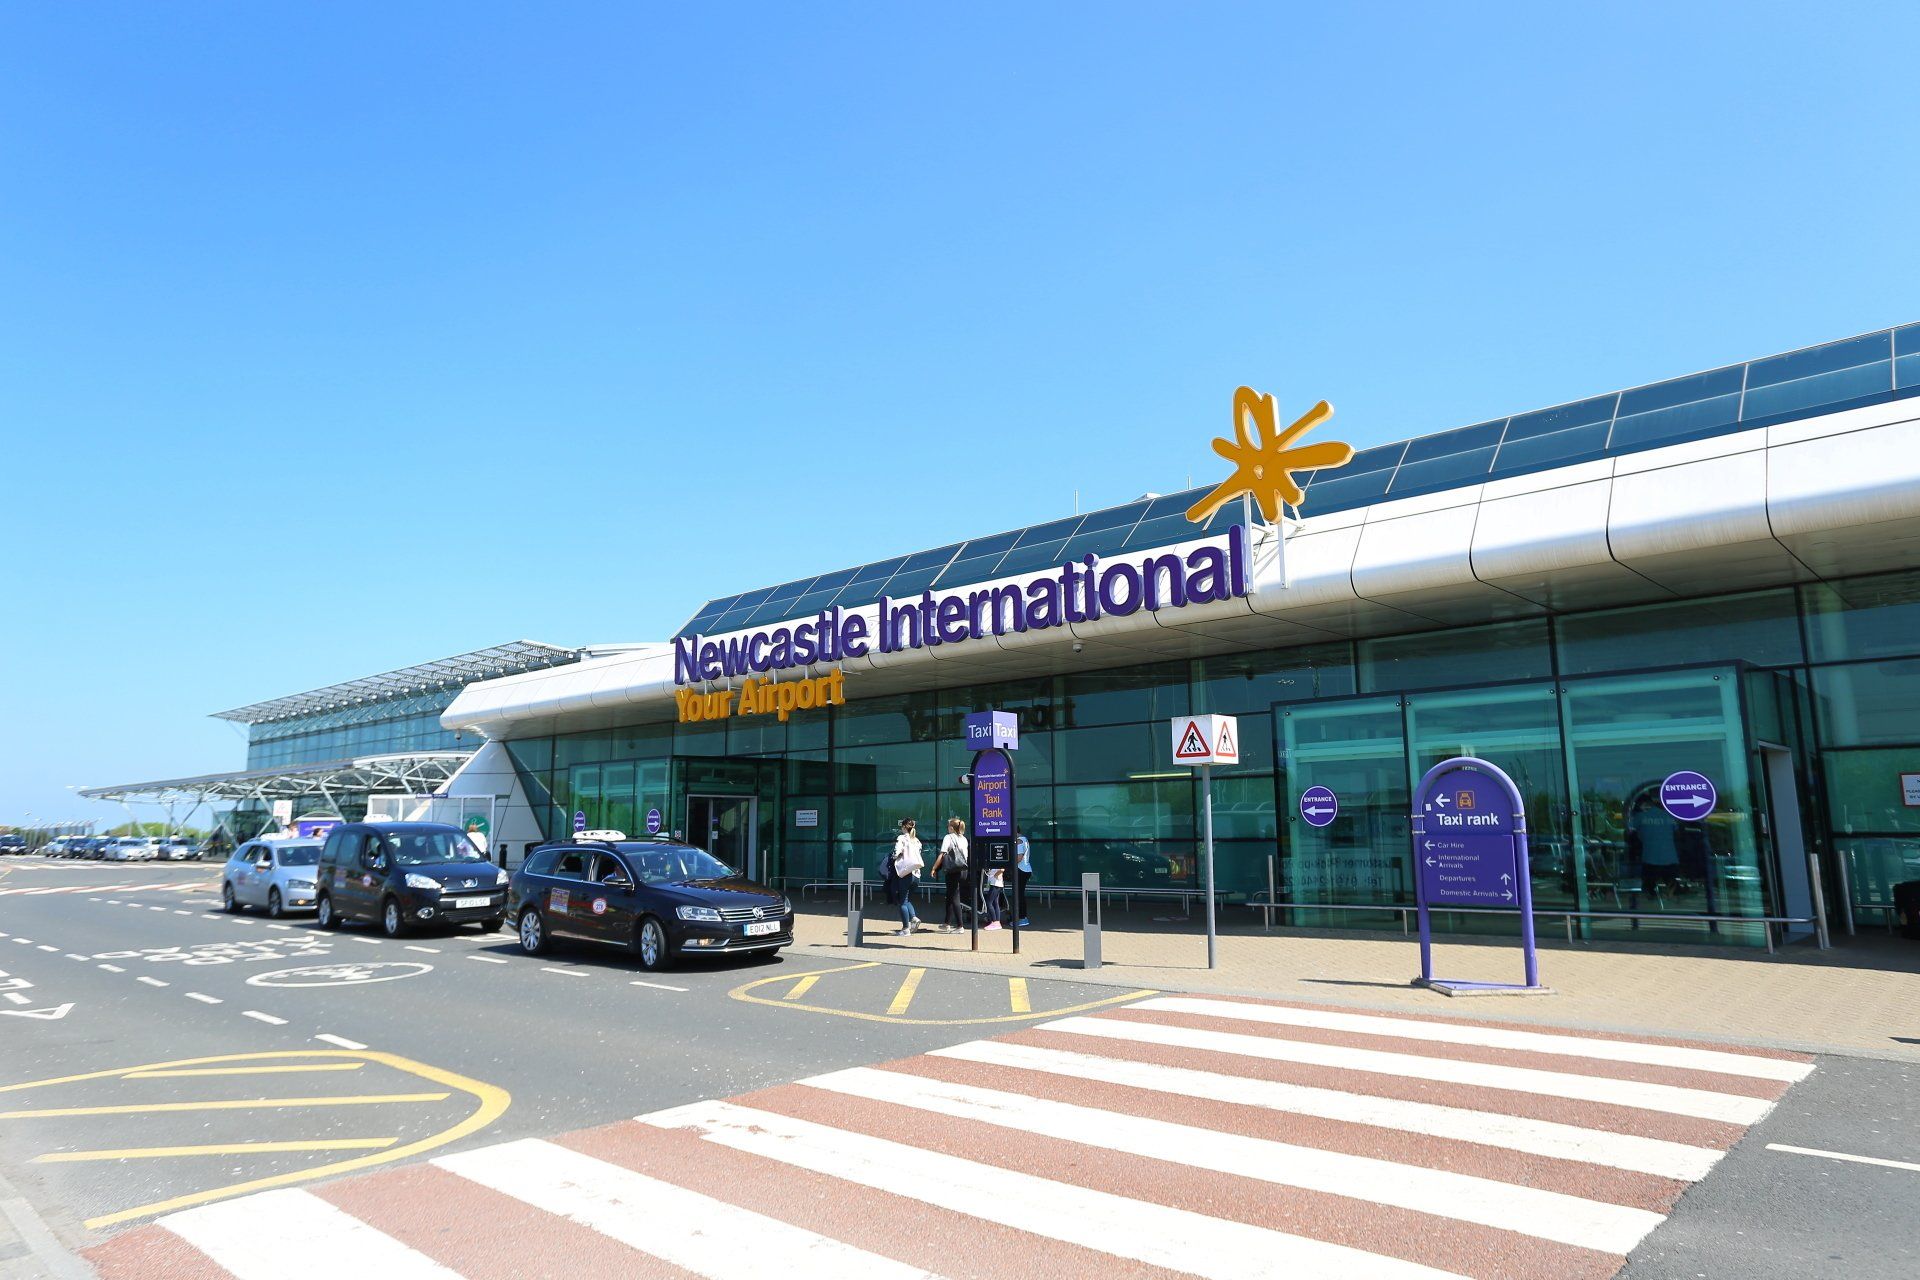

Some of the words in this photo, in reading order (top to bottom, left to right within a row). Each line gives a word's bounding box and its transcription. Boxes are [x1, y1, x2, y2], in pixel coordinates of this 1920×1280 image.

[674, 605, 867, 685] Newcastle
[879, 524, 1248, 654] International
[675, 686, 734, 723] Your
[737, 667, 846, 722] Airport
[968, 723, 992, 738] Taxi
[994, 722, 1016, 739] Taxi
[977, 780, 1007, 792] Airport
[1665, 783, 1707, 791] ENTRANCE
[984, 793, 1000, 804] Taxi
[982, 807, 1003, 818] Rank
[1436, 813, 1463, 826] Taxi
[1467, 812, 1499, 826] rank
[1439, 875, 1476, 883] Departures
[1440, 889, 1471, 897] Domestic
[1473, 890, 1499, 898] Arrivals
